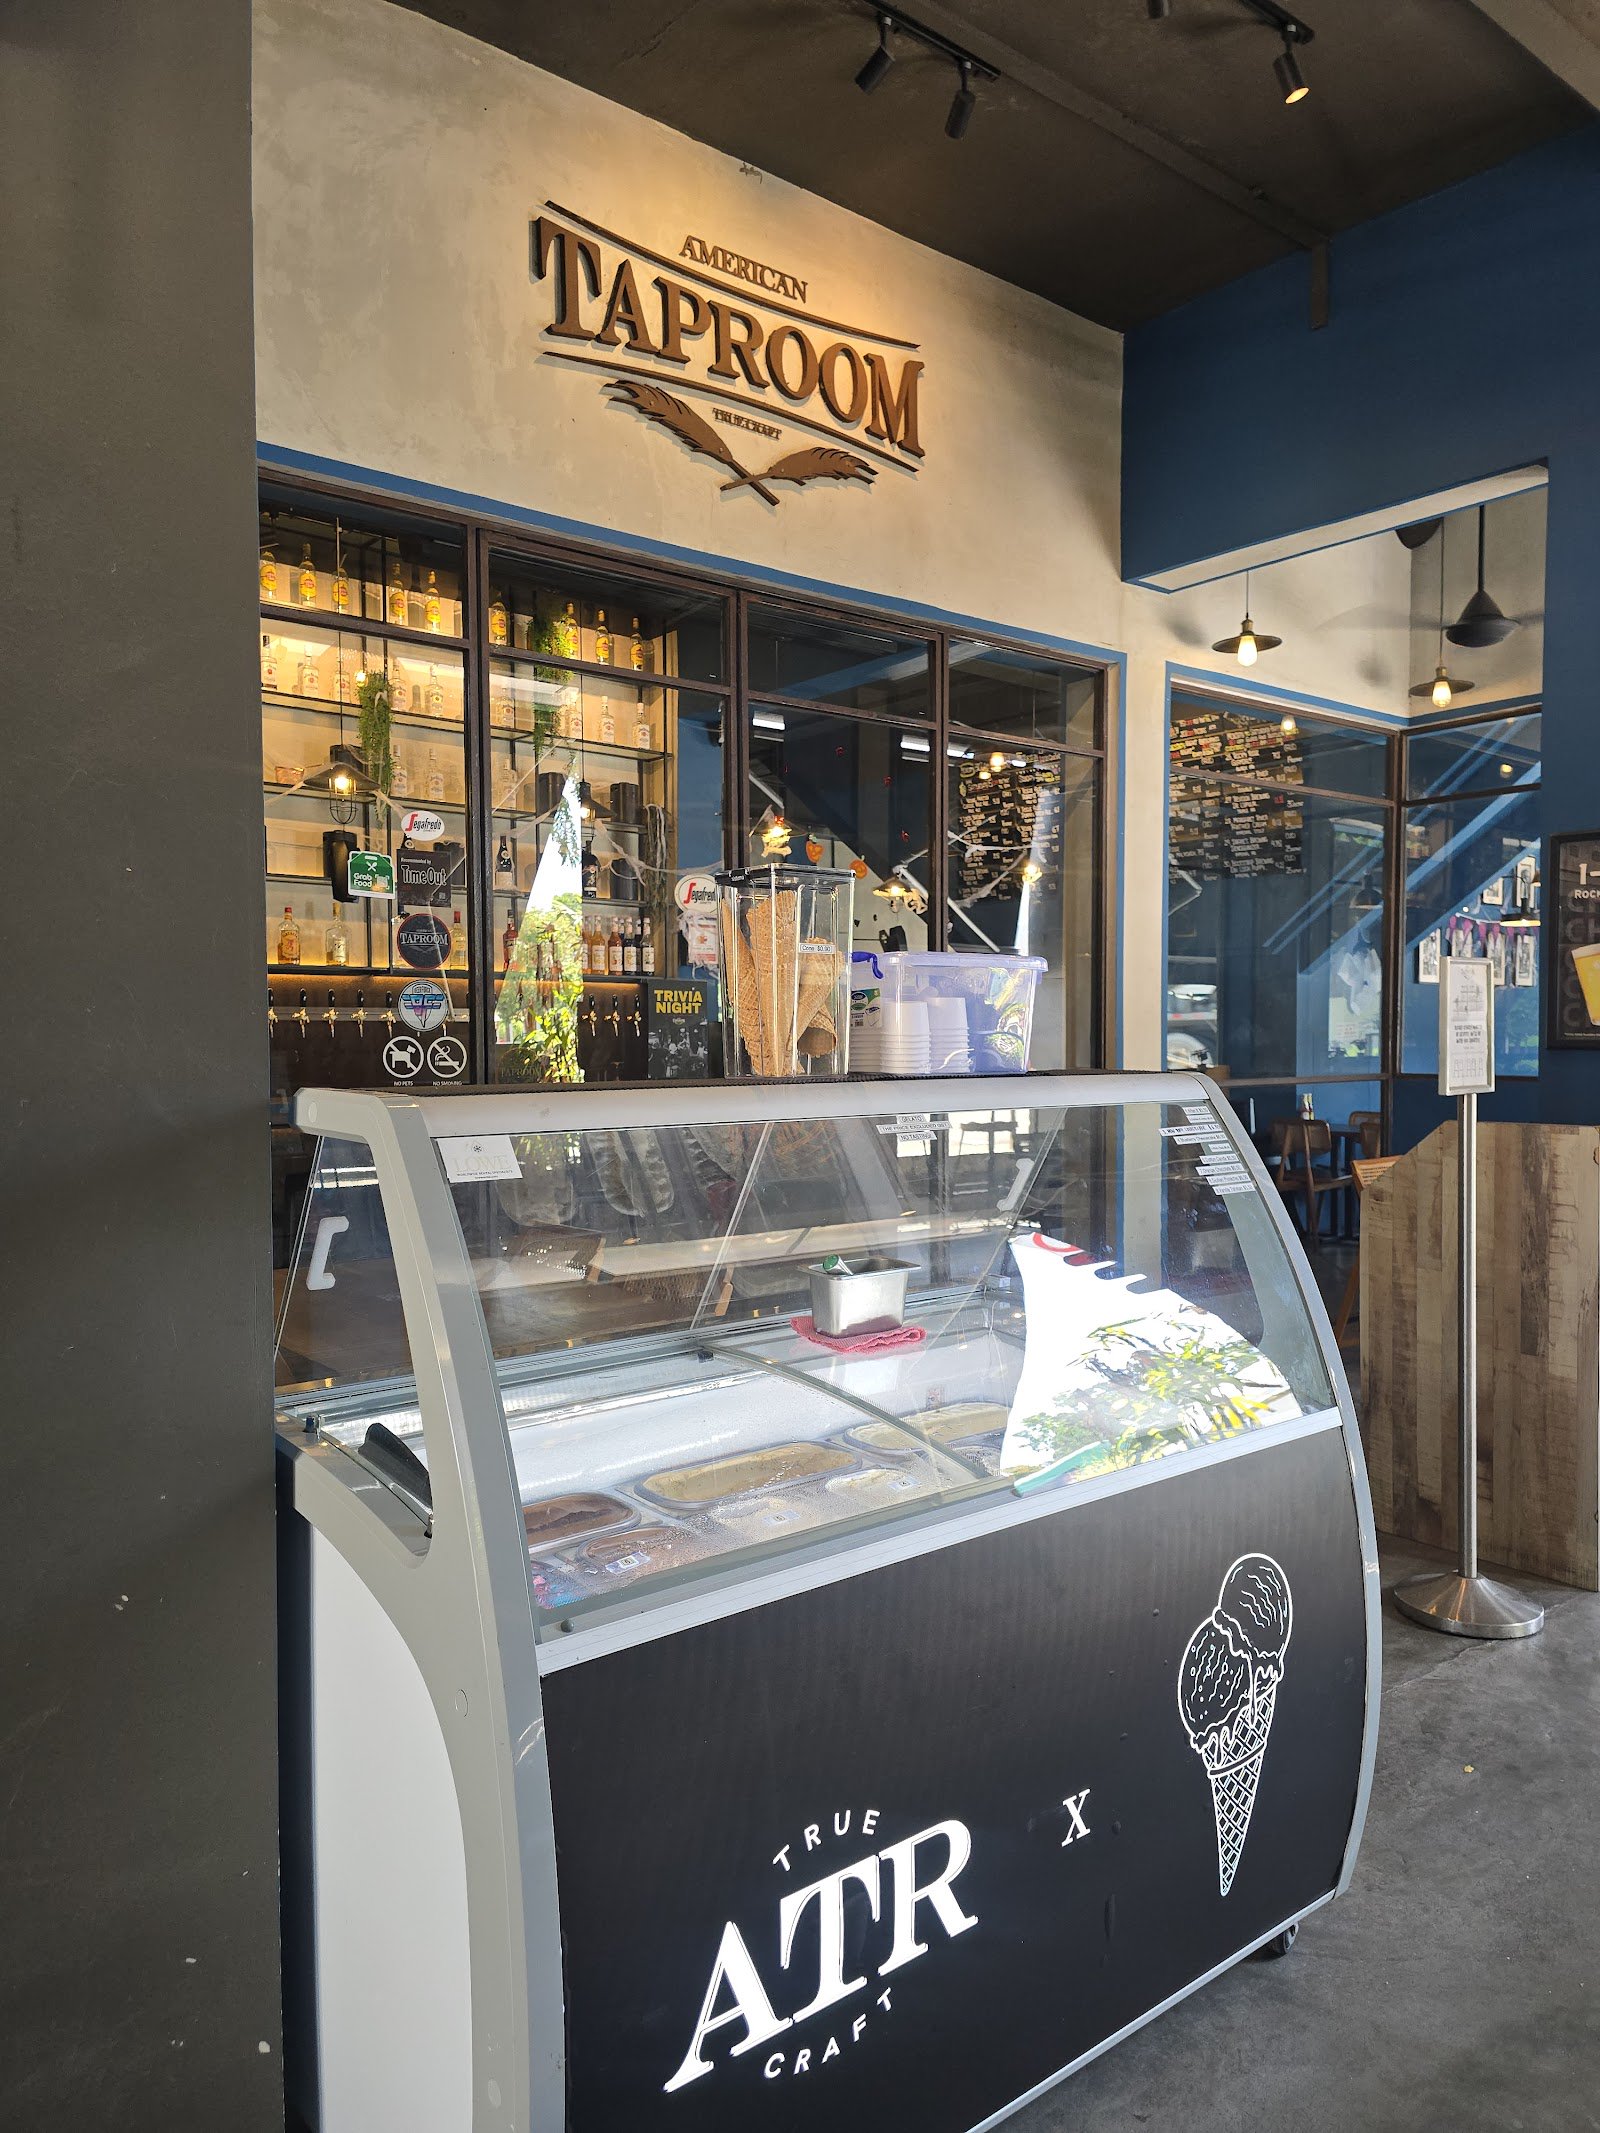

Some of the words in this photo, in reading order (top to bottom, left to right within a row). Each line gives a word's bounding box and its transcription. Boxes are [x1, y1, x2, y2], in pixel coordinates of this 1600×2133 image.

[679, 234, 809, 304] AMERICAN
[532, 215, 926, 459] TAPROOM
[405, 814, 441, 832] Segafredo
[353, 872, 372, 881] Grab
[353, 880, 372, 888] Food
[400, 932, 449, 946] TAPROOM
[654, 989, 703, 1003] TRIVIA
[655, 1002, 702, 1014] NIGHT
[1061, 1788, 1091, 1847] X
[772, 1809, 880, 1872] TRUE
[663, 1818, 979, 2093] ATR
[763, 1987, 893, 2079] CRAFT
